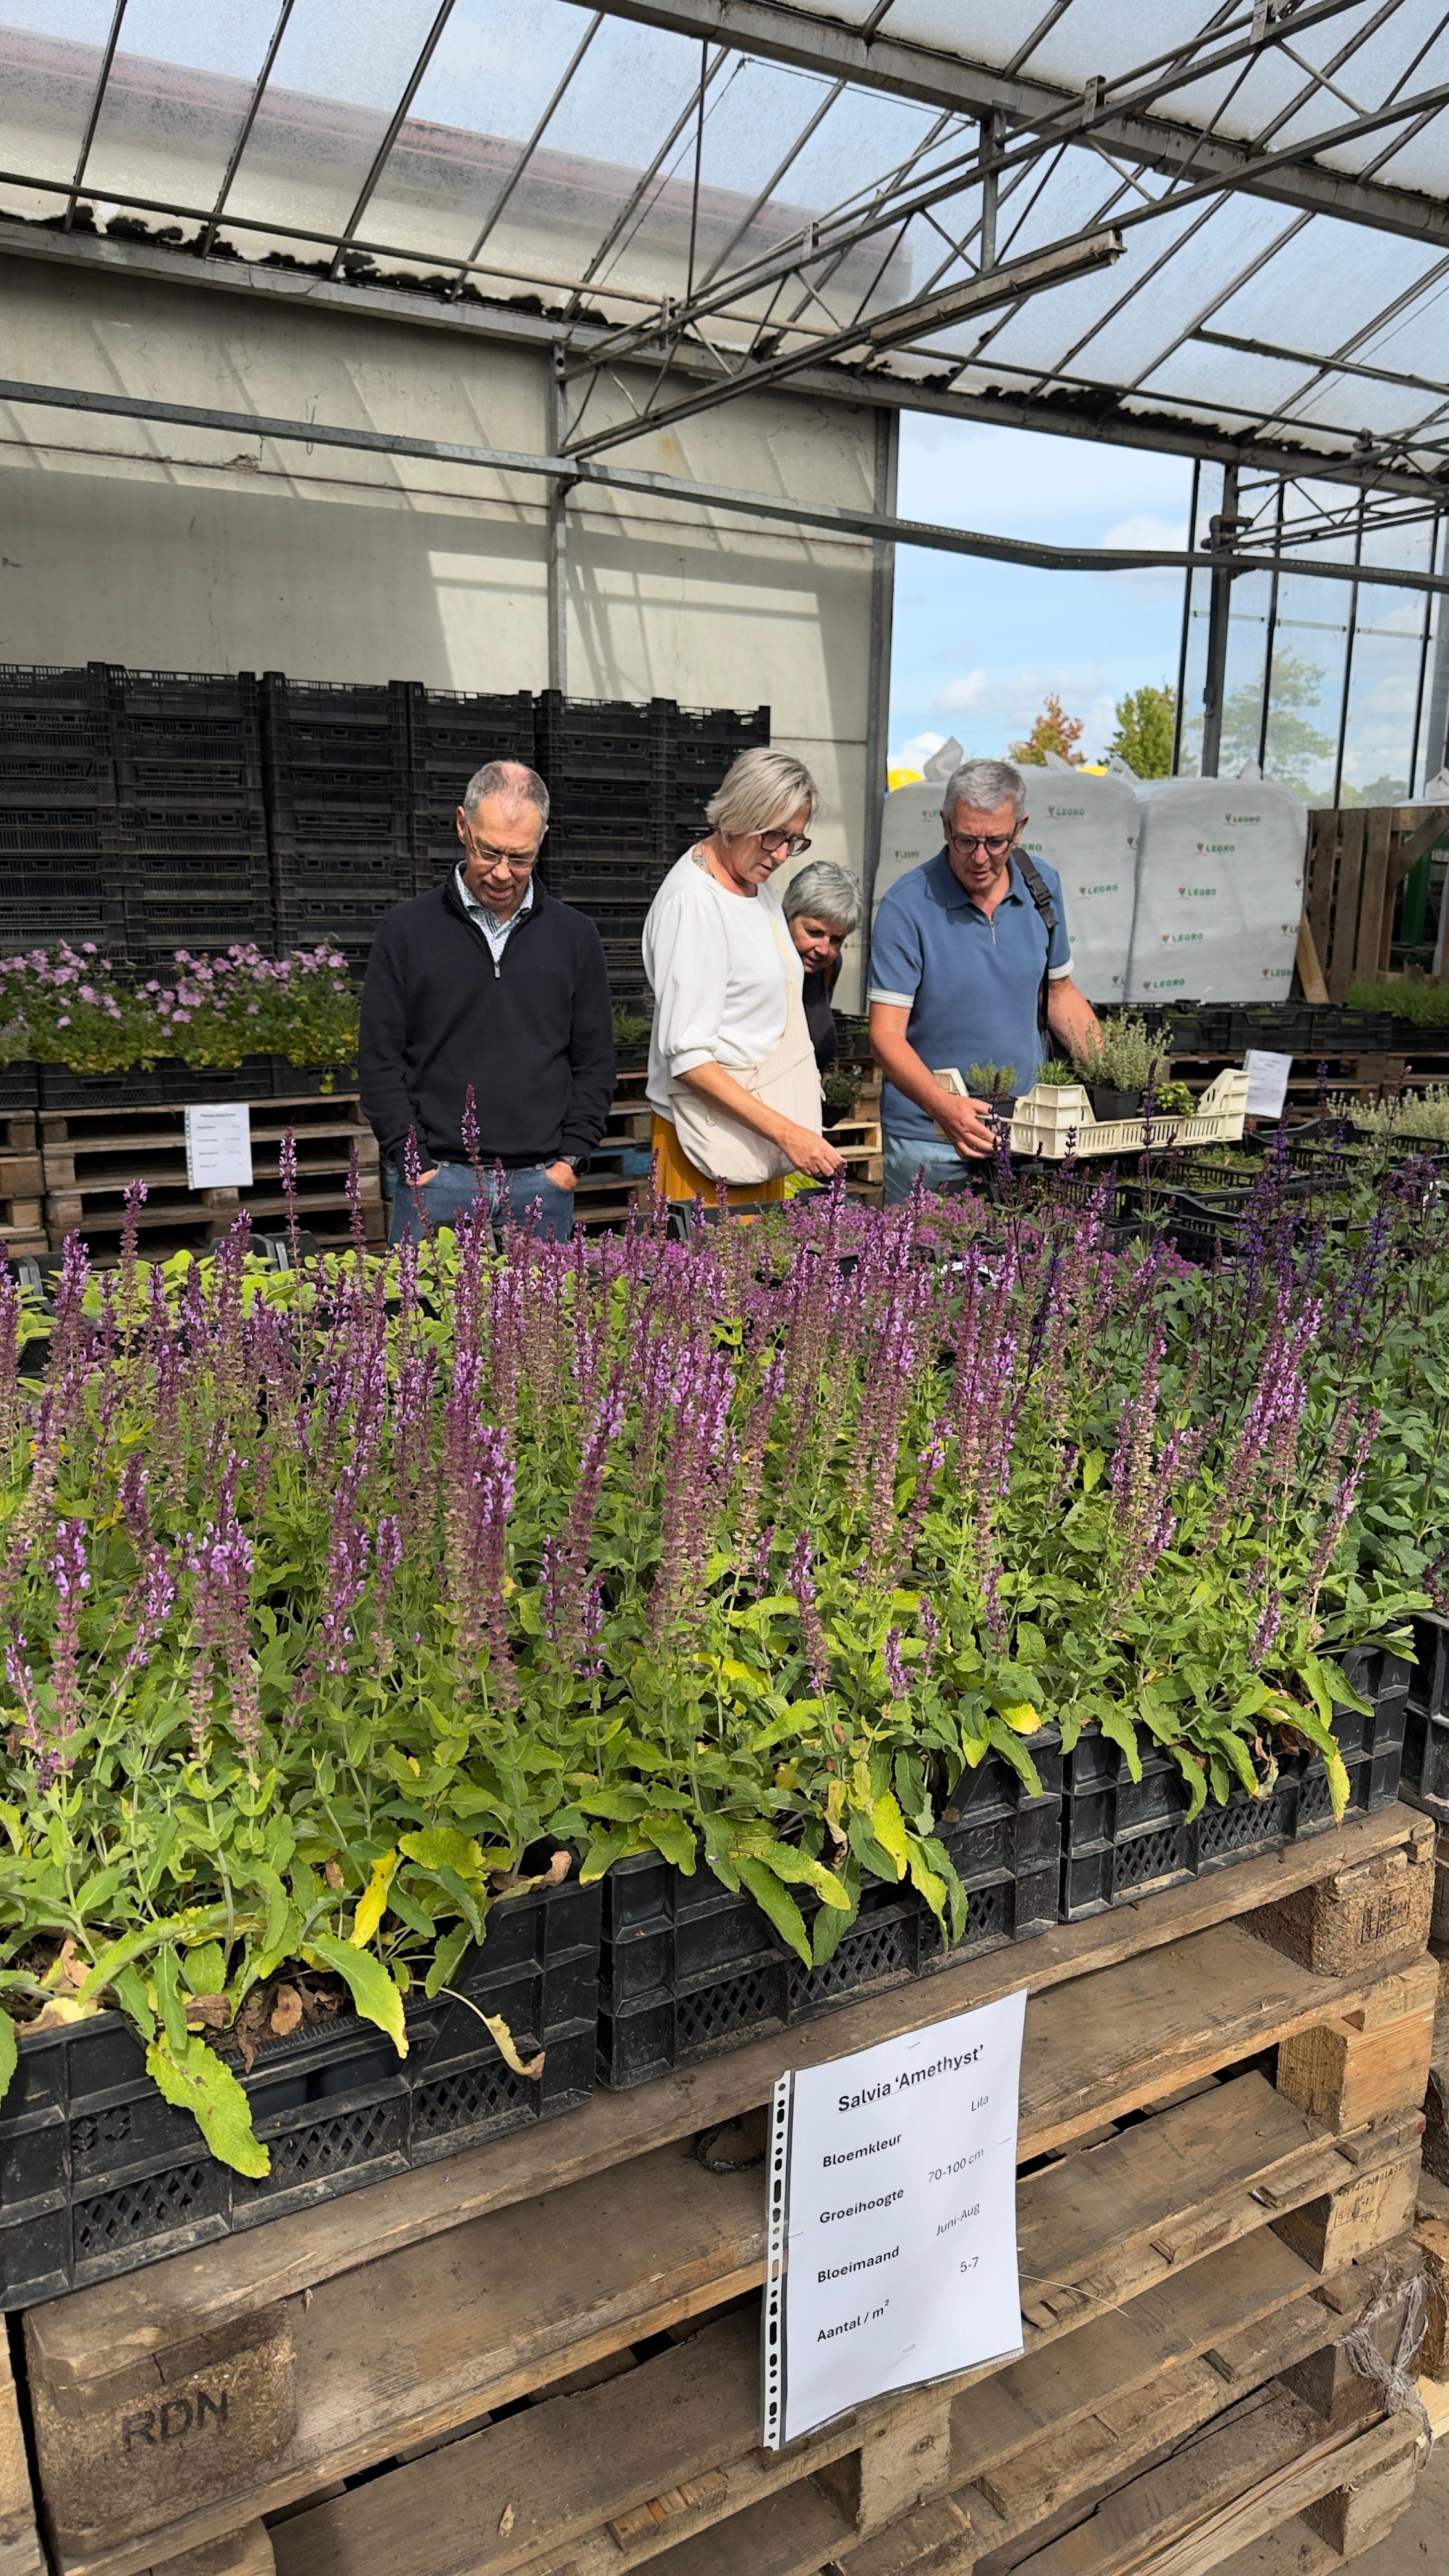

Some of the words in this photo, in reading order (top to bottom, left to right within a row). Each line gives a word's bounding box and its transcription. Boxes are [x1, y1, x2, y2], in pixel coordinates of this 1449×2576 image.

[1088, 884, 1118, 895] LEGRO
[1172, 933, 1204, 943] LEGRO
[1153, 978, 1185, 989] LEGRO
[838, 2083, 891, 2112] Salvia
[822, 2134, 902, 2168] Bloemkleur
[971, 2095, 989, 2112] Lila
[820, 2189, 904, 2224] Groeihoogte
[928, 2158, 966, 2183] 70-100
[968, 2148, 984, 2164] cm
[817, 2246, 900, 2283] Bloeimaand
[936, 2202, 980, 2236] Juni-Aug
[817, 2316, 861, 2342] Aantal
[960, 2257, 979, 2273] 5-7
[122, 2391, 228, 2452] RDN
